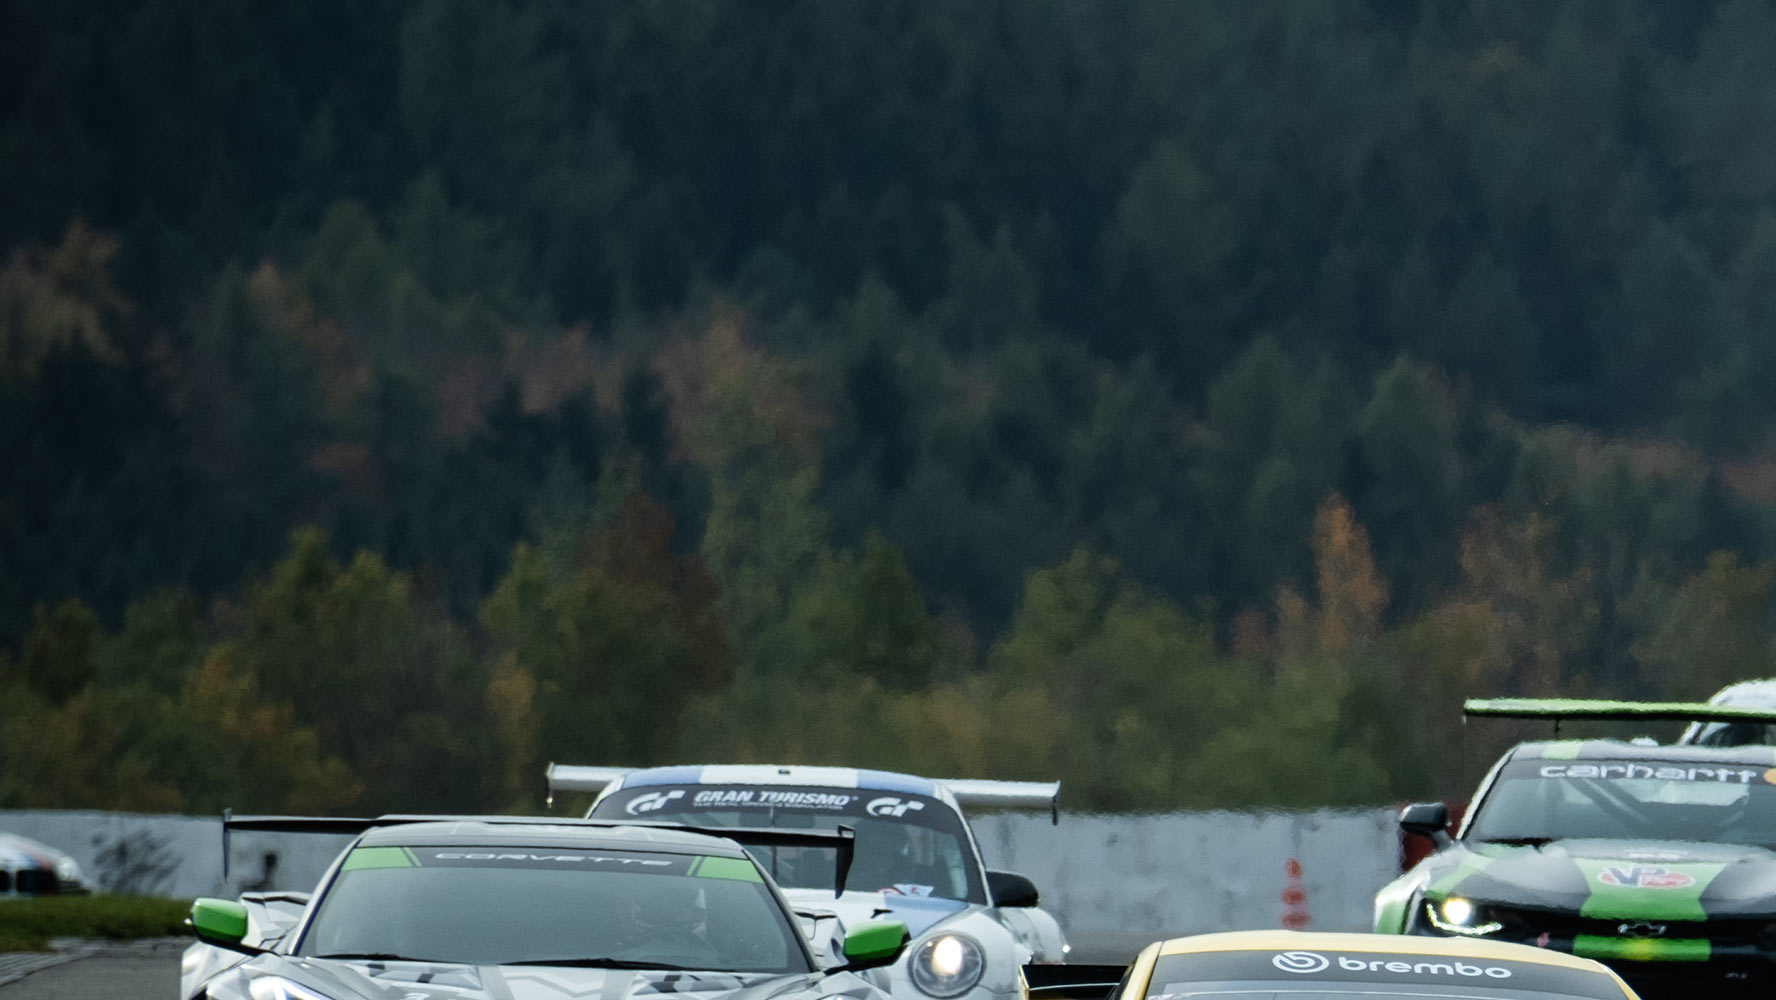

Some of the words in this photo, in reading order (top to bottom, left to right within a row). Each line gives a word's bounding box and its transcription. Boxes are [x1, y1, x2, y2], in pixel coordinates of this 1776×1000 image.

[1540, 763, 1757, 784] carhartt
[694, 790, 753, 803] GRAN
[435, 852, 673, 867] CORVETTE
[1337, 956, 1512, 979] brembo
